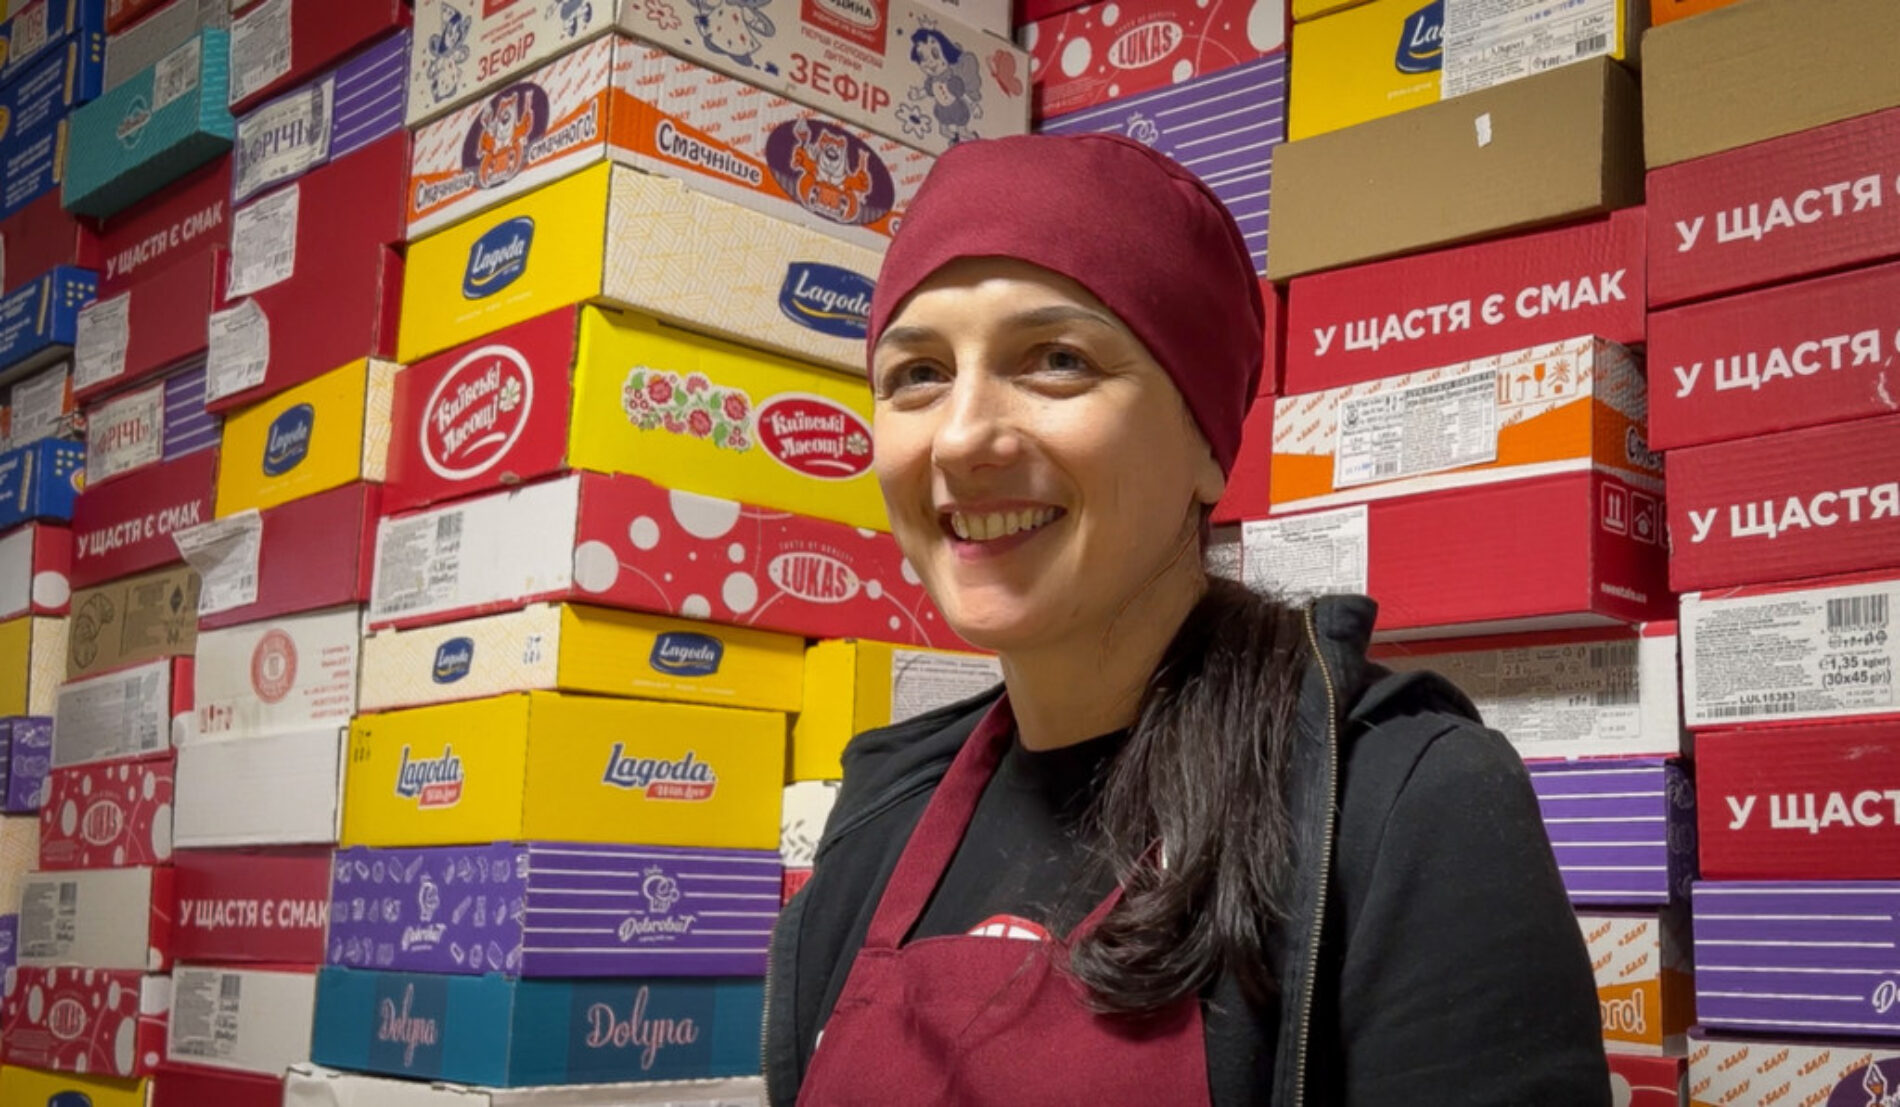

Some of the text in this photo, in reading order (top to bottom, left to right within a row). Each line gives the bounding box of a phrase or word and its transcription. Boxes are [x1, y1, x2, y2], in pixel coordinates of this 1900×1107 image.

[1118, 24, 1173, 64] LUKAS
[658, 123, 761, 184] Смачніше
[106, 258, 117, 281] У
[118, 232, 167, 276] ЩАСТЯ
[182, 201, 224, 242] СМАК
[1675, 174, 1881, 252] У ЩАСТЯ
[471, 234, 526, 274] Lagoda
[1314, 269, 1626, 356] У ЩАСТЯ Є СМАК
[1673, 329, 1880, 398] У ЩАСТЯ
[77, 535, 89, 560] У
[90, 519, 141, 556] ЩАСТЯ
[158, 500, 202, 534] СМАК
[1688, 482, 1900, 543] У ЩАСТЯ
[781, 556, 848, 598] LUKAS
[660, 637, 716, 662] Lagoda
[397, 746, 461, 797] Lagoda
[603, 743, 711, 787] Lagoda
[1726, 795, 1757, 830] У
[180, 899, 331, 931] У ЩАСТЯ Є СМАК
[379, 982, 438, 1068] Dolyna
[587, 985, 699, 1071] Dolyna
